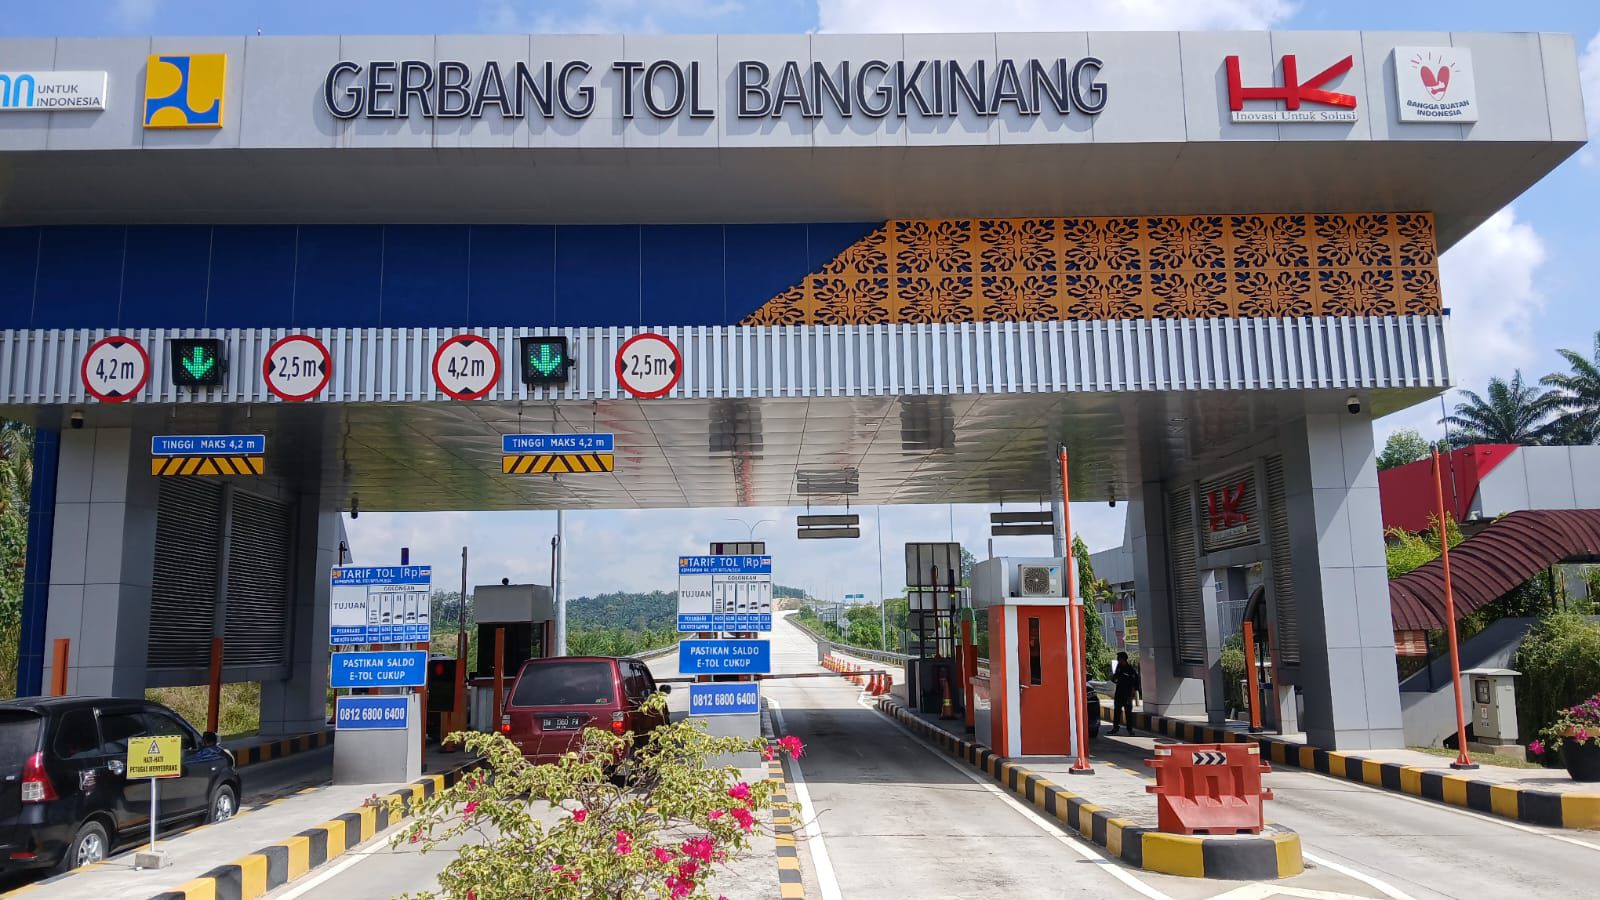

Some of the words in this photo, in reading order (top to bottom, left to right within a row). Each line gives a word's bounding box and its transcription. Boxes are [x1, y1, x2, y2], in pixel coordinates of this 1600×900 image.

[324, 59, 596, 119] GERBANG
[612, 59, 716, 118] TOL
[736, 56, 1108, 118] BANGKINANG
[1225, 54, 1356, 111] HK
[38, 84, 78, 94] UNTUK
[36, 96, 100, 107] INDONESIA
[1406, 100, 1439, 110] BANGGA
[1440, 100, 1470, 110] BUATAN
[1236, 112, 1277, 121] Inovasi
[1281, 112, 1316, 121] Untuk
[1320, 112, 1356, 121] Solusi
[1416, 109, 1462, 117] INDONESIA
[162, 440, 194, 449] TINGGI
[200, 440, 226, 449] MAKS
[229, 440, 244, 450] 4,2
[246, 440, 255, 448] m
[512, 438, 544, 448] TINGGI
[550, 438, 576, 447] MAKS
[578, 438, 593, 448] 4,2
[688, 558, 716, 567] TARIF
[720, 558, 738, 567] TOL
[342, 569, 371, 579] TARIF
[376, 568, 396, 578] TOL
[681, 590, 711, 598] TUJUAN
[334, 602, 366, 610] TUJUAN
[690, 647, 729, 655] PASTIKAN
[732, 646, 759, 654] SALDO
[343, 659, 383, 668] PASTIKAN
[387, 658, 414, 666] SALDO
[696, 658, 720, 668] E-TOL
[724, 658, 751, 667] CUKUP
[349, 672, 373, 680] E-TOL
[377, 671, 405, 680] CUKUP
[693, 694, 712, 706] 0812
[714, 694, 734, 706] 6800
[736, 692, 756, 705] 6400
[340, 708, 360, 720] 0812
[362, 708, 382, 720] 6800
[384, 707, 404, 720] 6400
